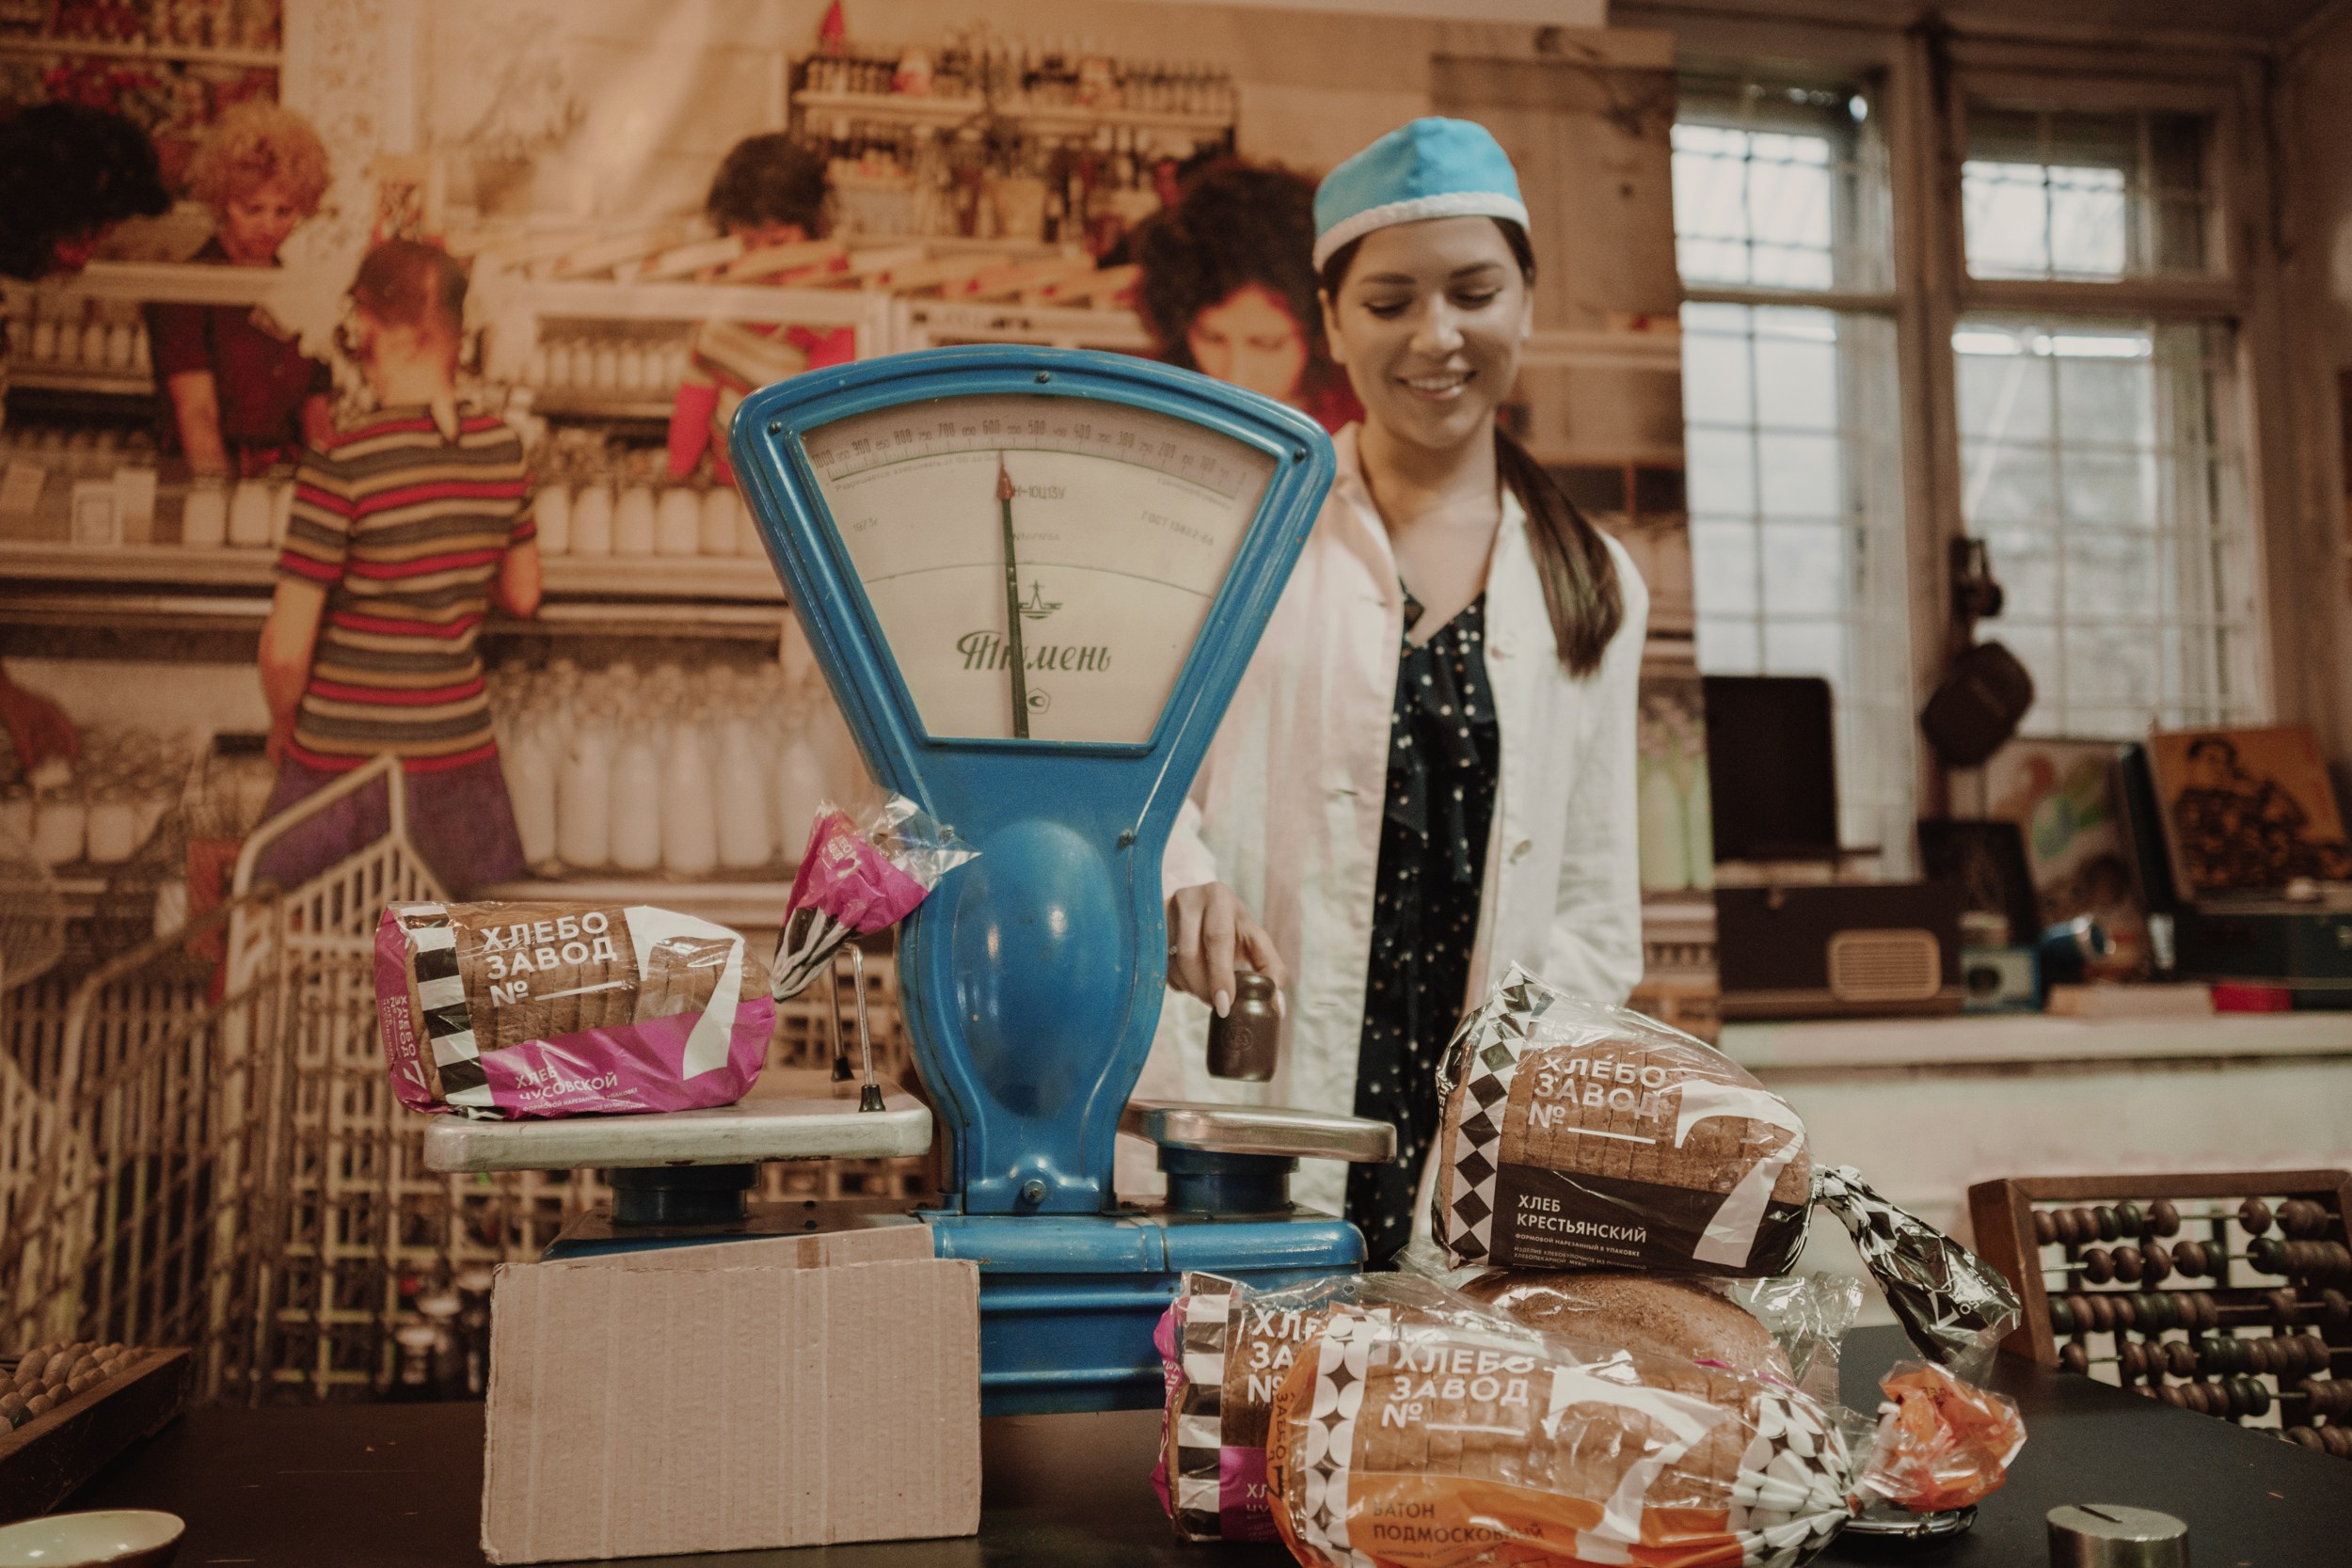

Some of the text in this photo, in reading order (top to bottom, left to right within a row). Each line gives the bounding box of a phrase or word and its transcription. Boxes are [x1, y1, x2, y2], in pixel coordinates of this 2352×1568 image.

[812, 450, 834, 468] 1000
[851, 438, 871, 455] 900
[894, 428, 912, 445] 800
[917, 431, 932, 441] 750
[938, 422, 954, 437] 700
[982, 420, 1000, 435] 600
[1027, 420, 1045, 436] 500
[1073, 424, 1091, 440] 400
[1118, 431, 1135, 448] 300
[1157, 442, 1176, 459] 200
[1141, 510, 1168, 527] ГОСТ
[480, 911, 609, 952] ХЛЕБО
[485, 936, 618, 980] ЗАВОД
[489, 980, 529, 1007] №
[394, 996, 409, 1057] ЗАВОД
[400, 995, 416, 1057] ХЛЕБО
[515, 1065, 558, 1089] ХЛЕБ
[519, 1071, 618, 1101] ЧУСОВСКОЙ
[1538, 1056, 1667, 1088] ХЛЕБО
[522, 1100, 563, 1113] ФОРМОВОЙ
[563, 1094, 603, 1106] НАРЕЗАНН
[1534, 1073, 1661, 1124] ЗАВОД
[1528, 1101, 1566, 1129] №
[1518, 1195, 1561, 1212] ХЛЕБ
[1517, 1213, 1646, 1243] КРЕСТЬЯНСКИЙ
[1514, 1245, 1542, 1256] ИЗДЕЛИЕ
[1543, 1250, 1596, 1263] ХЛЕБОБУЛОЧНОЕ
[1514, 1253, 1566, 1264] ХЛЕБОПЕКАРНОЙ
[1515, 1233, 1554, 1243] ФОРМОВОЙ
[1555, 1239, 1599, 1251] НАРЕЗАННЫЙ
[1606, 1246, 1640, 1257] УПАКОВКЕ
[1394, 1341, 1536, 1375] ХЛЕБО
[1390, 1375, 1530, 1407] ЗАВОД
[1381, 1402, 1423, 1428] №
[1374, 1502, 1435, 1519] БАТОН
